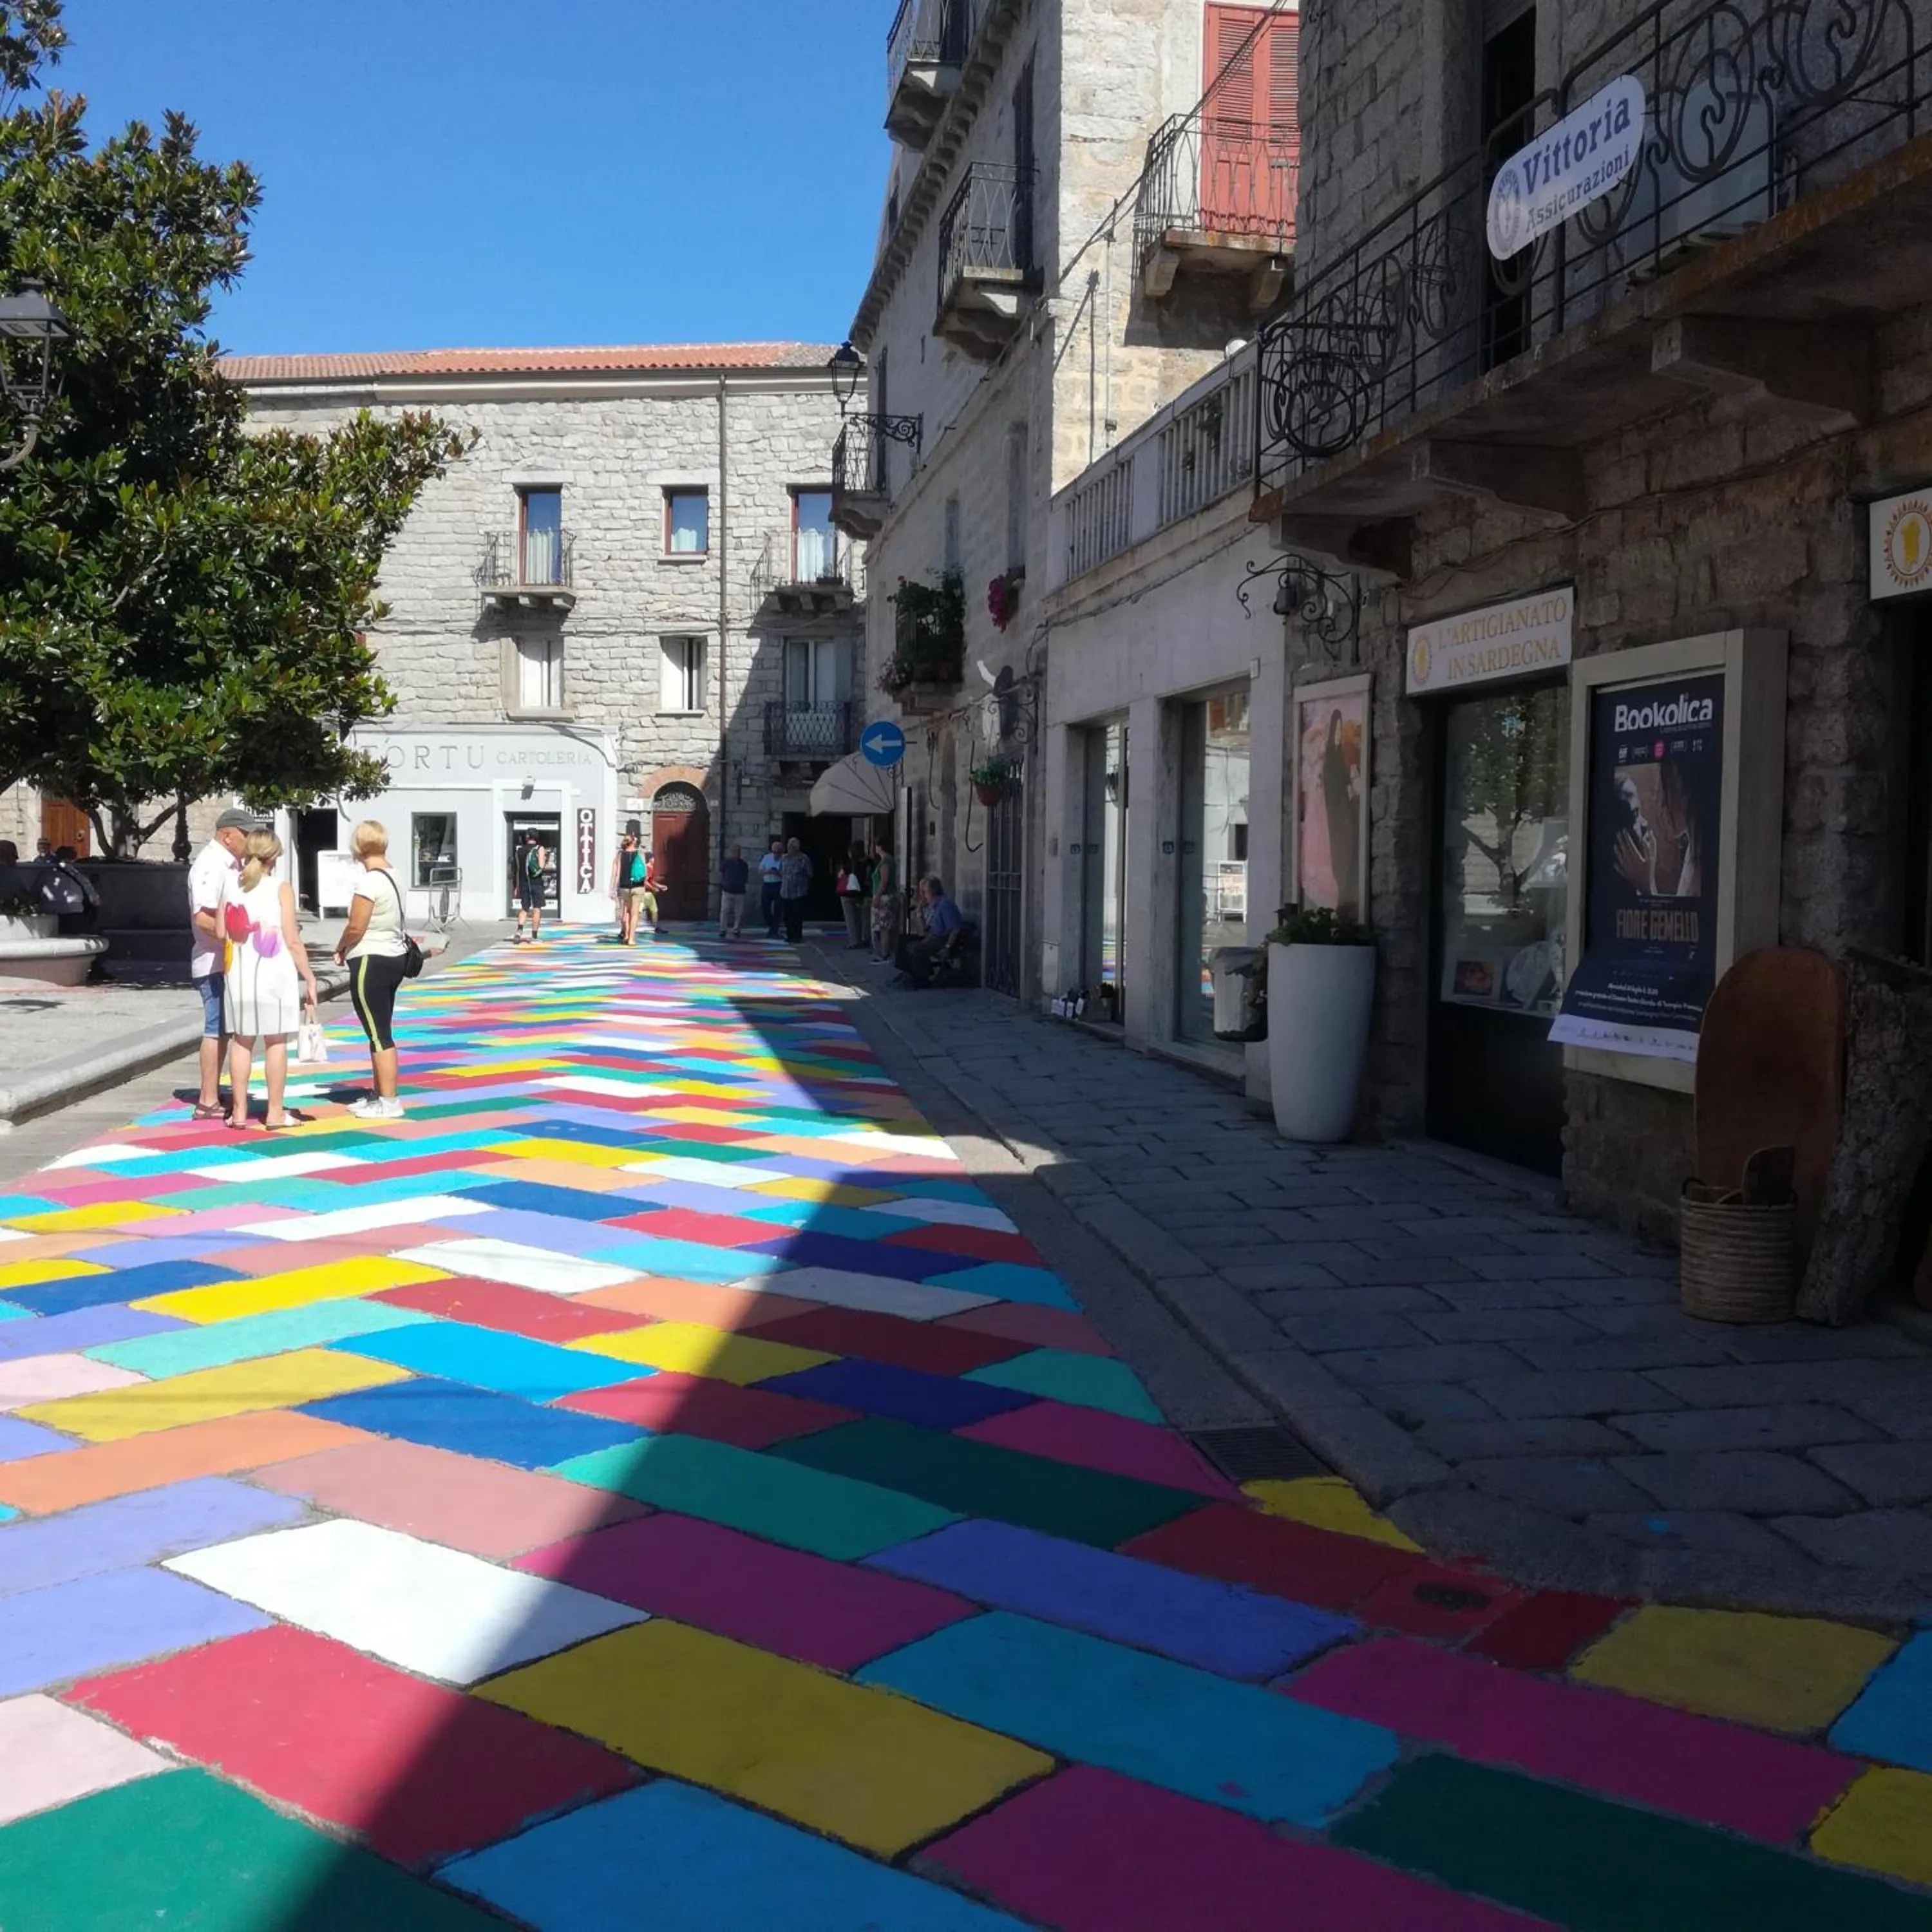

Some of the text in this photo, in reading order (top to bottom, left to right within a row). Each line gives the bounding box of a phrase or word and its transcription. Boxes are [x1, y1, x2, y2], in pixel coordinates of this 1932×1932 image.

[1522, 97, 1630, 195] Vittoria
[1526, 144, 1629, 232] Assicurazioni
[1437, 596, 1566, 650] L'ARTIGIANATO
[1448, 636, 1561, 679] IN SARDEGNA
[1615, 693, 1713, 732] Bookolica
[496, 750, 592, 766] CARTOLERIA
[579, 809, 593, 893] OTTICA
